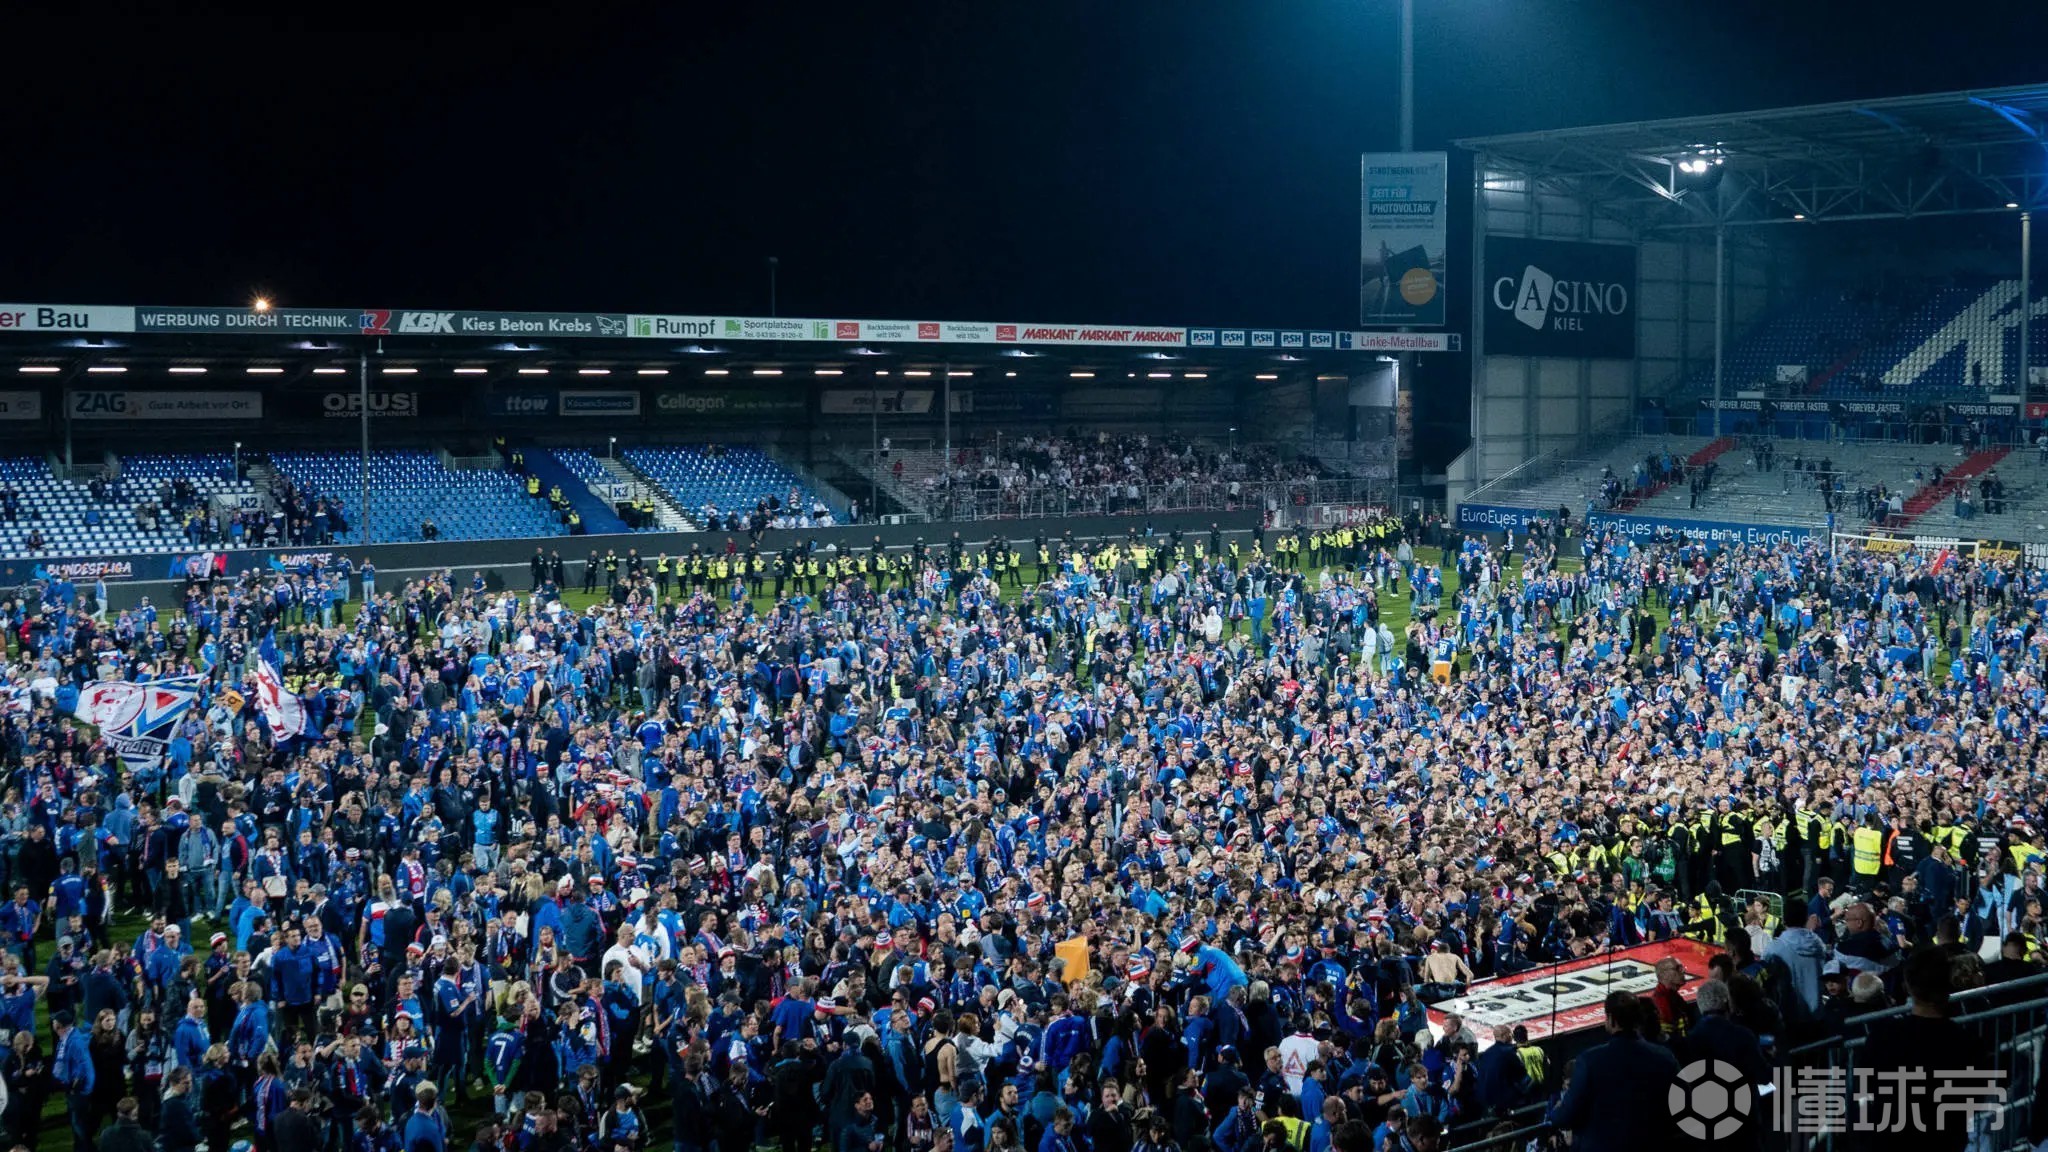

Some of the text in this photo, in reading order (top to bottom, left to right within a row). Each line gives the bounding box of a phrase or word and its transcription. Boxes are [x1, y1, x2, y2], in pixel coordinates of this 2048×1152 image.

[1371, 203, 1431, 213] PHOTOVOLTAIK
[1493, 276, 1628, 315] CASINO
[37, 307, 88, 328] Bau
[141, 313, 353, 328] WERBUNG DURCH TECHNIK.
[398, 312, 592, 333] KBK Kies Beton Krebs
[744, 320, 804, 330] Sportplatzbau
[1553, 317, 1584, 331] KIEL
[656, 317, 716, 338] Rumpf
[1022, 328, 1078, 341] MARKANT
[1078, 330, 1133, 342] MARKANT
[1132, 331, 1185, 343] MARKANT
[1360, 335, 1439, 348] Linke-Metallbau
[76, 393, 126, 412] ZAG
[323, 393, 410, 411] OPUS
[656, 393, 725, 412] Cellagon
[1709, 400, 1740, 409] FREVER.
[239, 497, 258, 508] K2
[1461, 508, 1518, 529] EuroEyes
[2025, 542, 2048, 557] CON
[494, 1040, 507, 1066] 7
